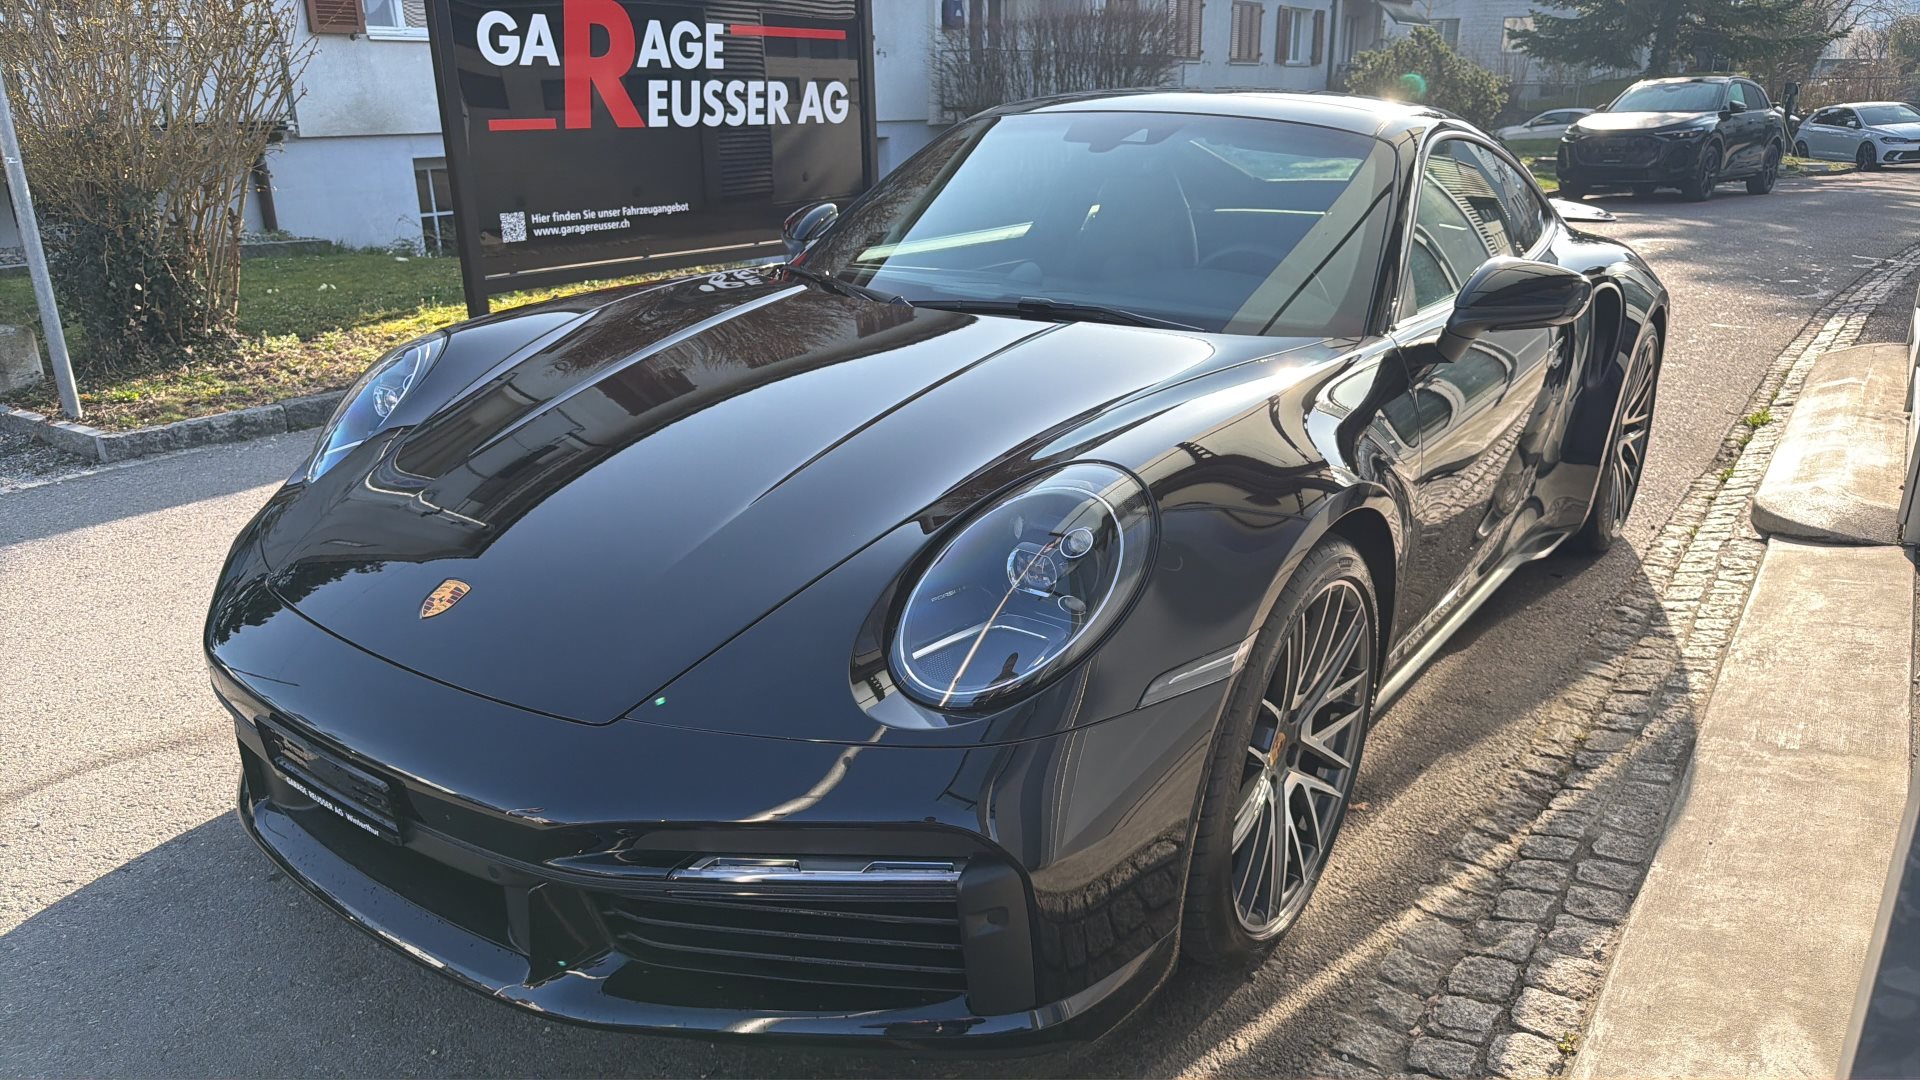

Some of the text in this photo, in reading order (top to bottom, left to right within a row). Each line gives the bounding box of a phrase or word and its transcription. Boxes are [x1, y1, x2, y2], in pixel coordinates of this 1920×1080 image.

[476, 0, 725, 129] GARAGE
[797, 81, 849, 125] AG
[531, 202, 689, 224] Hier finden Sie unser Fahrzeugangebot
[533, 219, 630, 237] www.garagereusser.ch
